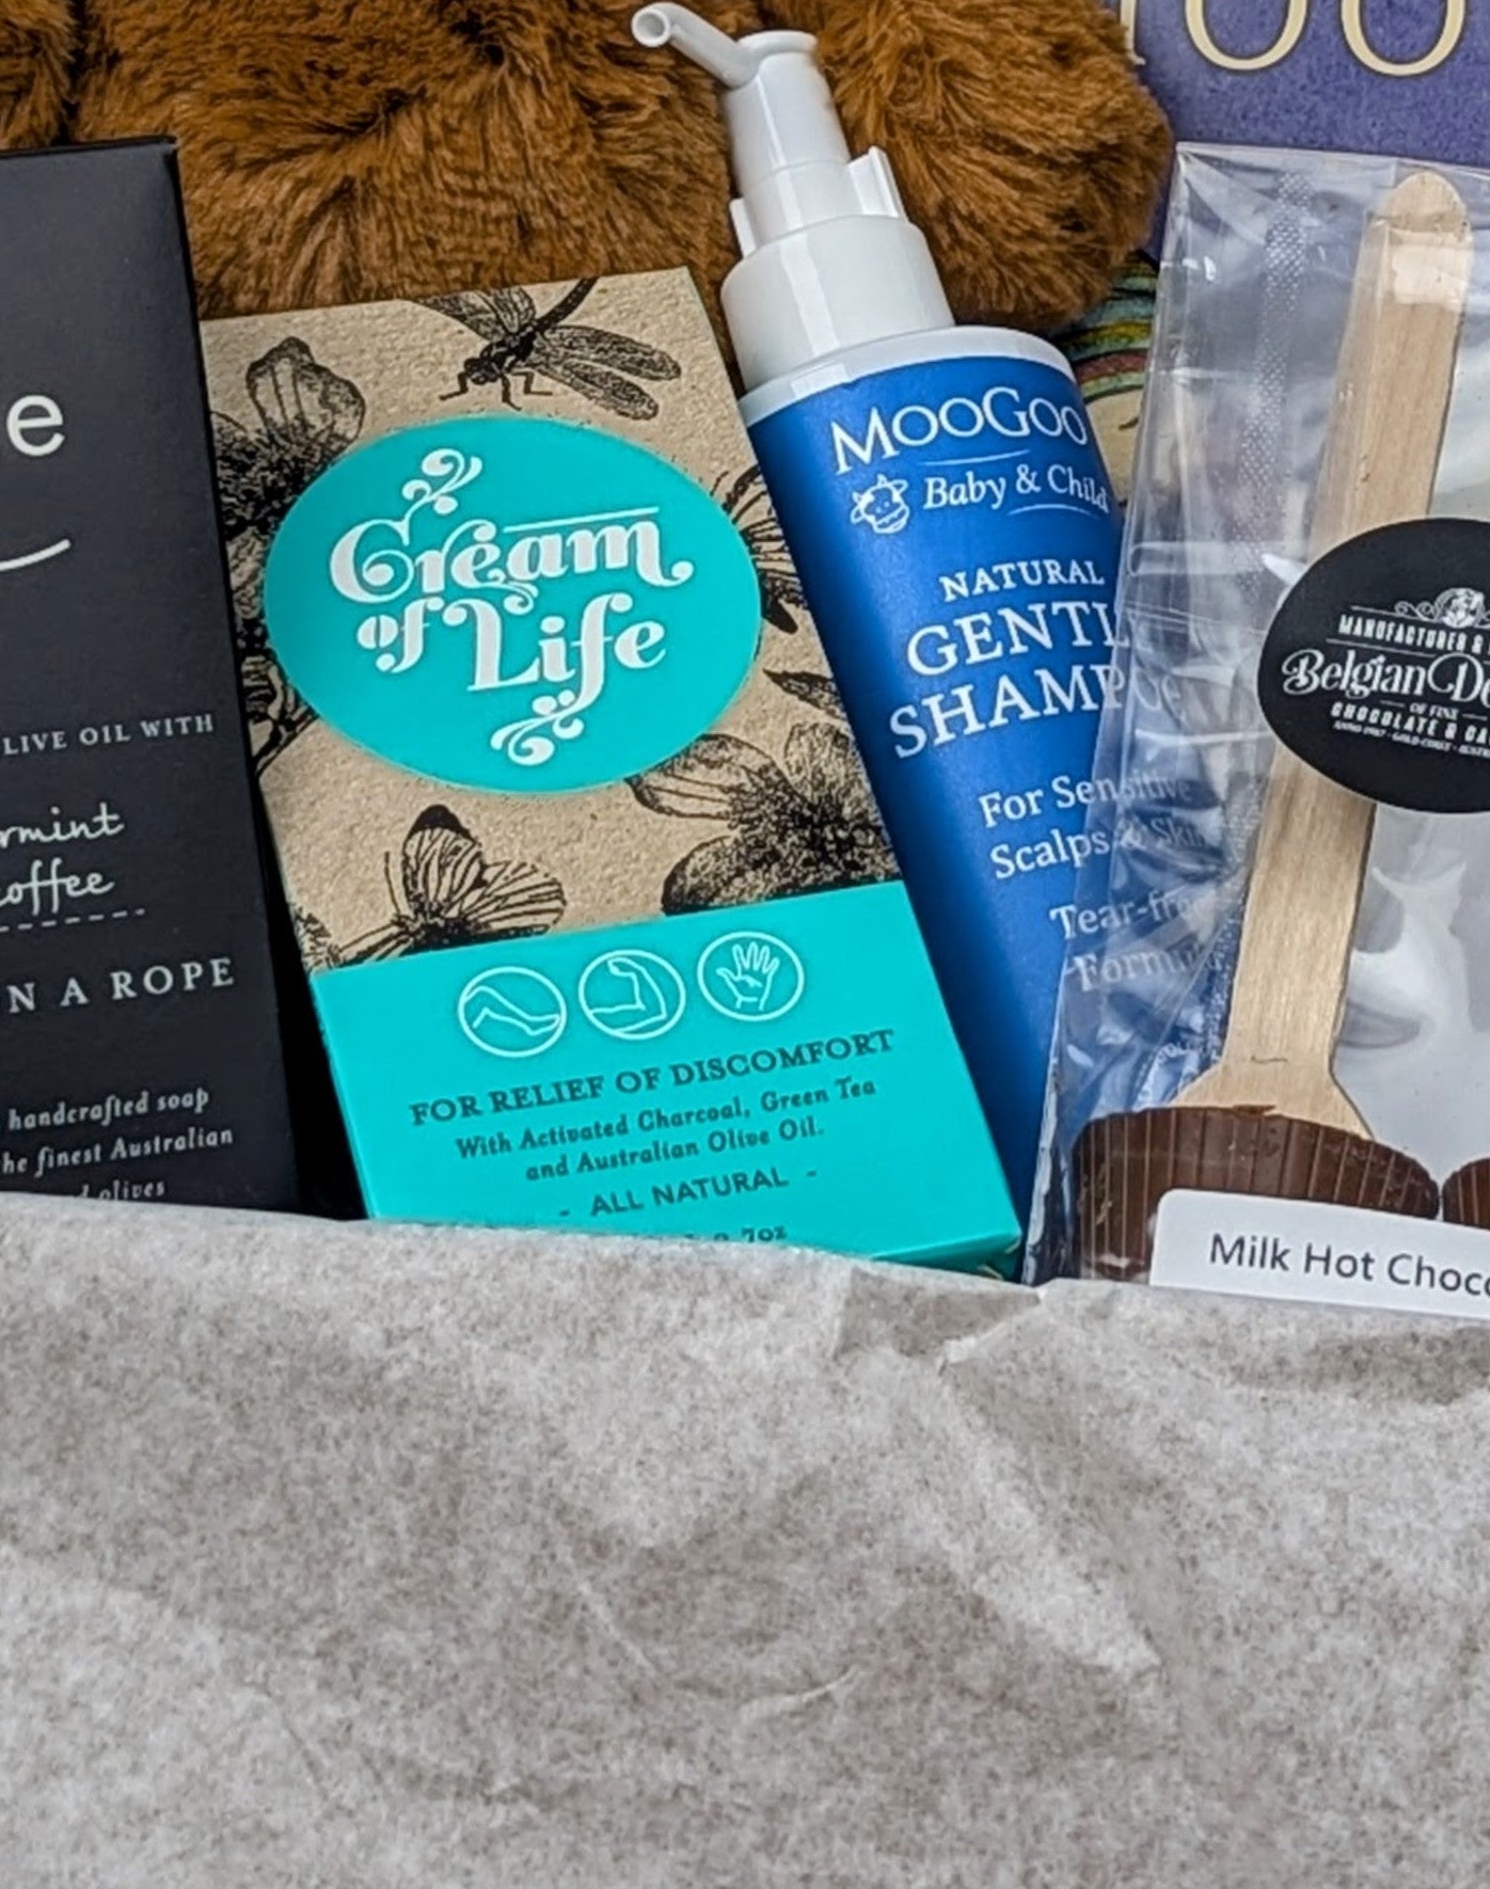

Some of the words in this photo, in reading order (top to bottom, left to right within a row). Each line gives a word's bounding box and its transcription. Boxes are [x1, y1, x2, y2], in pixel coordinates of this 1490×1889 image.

[924, 471, 1007, 510] Baby
[1015, 464, 1041, 495] &
[1048, 464, 1109, 512] Child
[329, 448, 695, 614] Cream
[939, 559, 1106, 602] NATURAL
[1338, 614, 1468, 651] MANUFACTURER
[1471, 634, 1484, 654] &
[357, 595, 445, 673] of
[442, 593, 667, 765] Life
[1281, 648, 1427, 699] Belgian
[80, 722, 130, 747] OIL
[141, 714, 214, 737] WITH
[1330, 701, 1439, 736] CHOCOLATE
[1444, 722, 1458, 740] &
[979, 788, 1044, 828] For
[990, 828, 1111, 880] Scalps
[60, 979, 89, 1007] A
[110, 957, 236, 999] ROPE
[410, 1095, 483, 1127] FOR
[488, 1076, 605, 1114] RELIEF
[615, 1067, 661, 1094] OF
[670, 1028, 895, 1087] DISCOMFORT
[9, 1090, 149, 1131] handcrafted
[157, 1088, 209, 1114] soap
[455, 1133, 512, 1160] With
[520, 1114, 629, 1150] Activated
[638, 1096, 751, 1133] Charcoal,
[761, 1085, 830, 1114] Green
[835, 1075, 876, 1099] Tea
[35, 1143, 102, 1178] finest
[109, 1126, 234, 1160] Australian
[526, 1155, 570, 1182] and
[576, 1135, 700, 1174] Australian
[708, 1126, 770, 1153] Olive
[779, 1116, 824, 1143] Oil.
[590, 1189, 644, 1217] ALL
[652, 1166, 790, 1206] NATURAL
[1210, 1233, 1290, 1271] Milk
[1304, 1242, 1376, 1282] Hot
